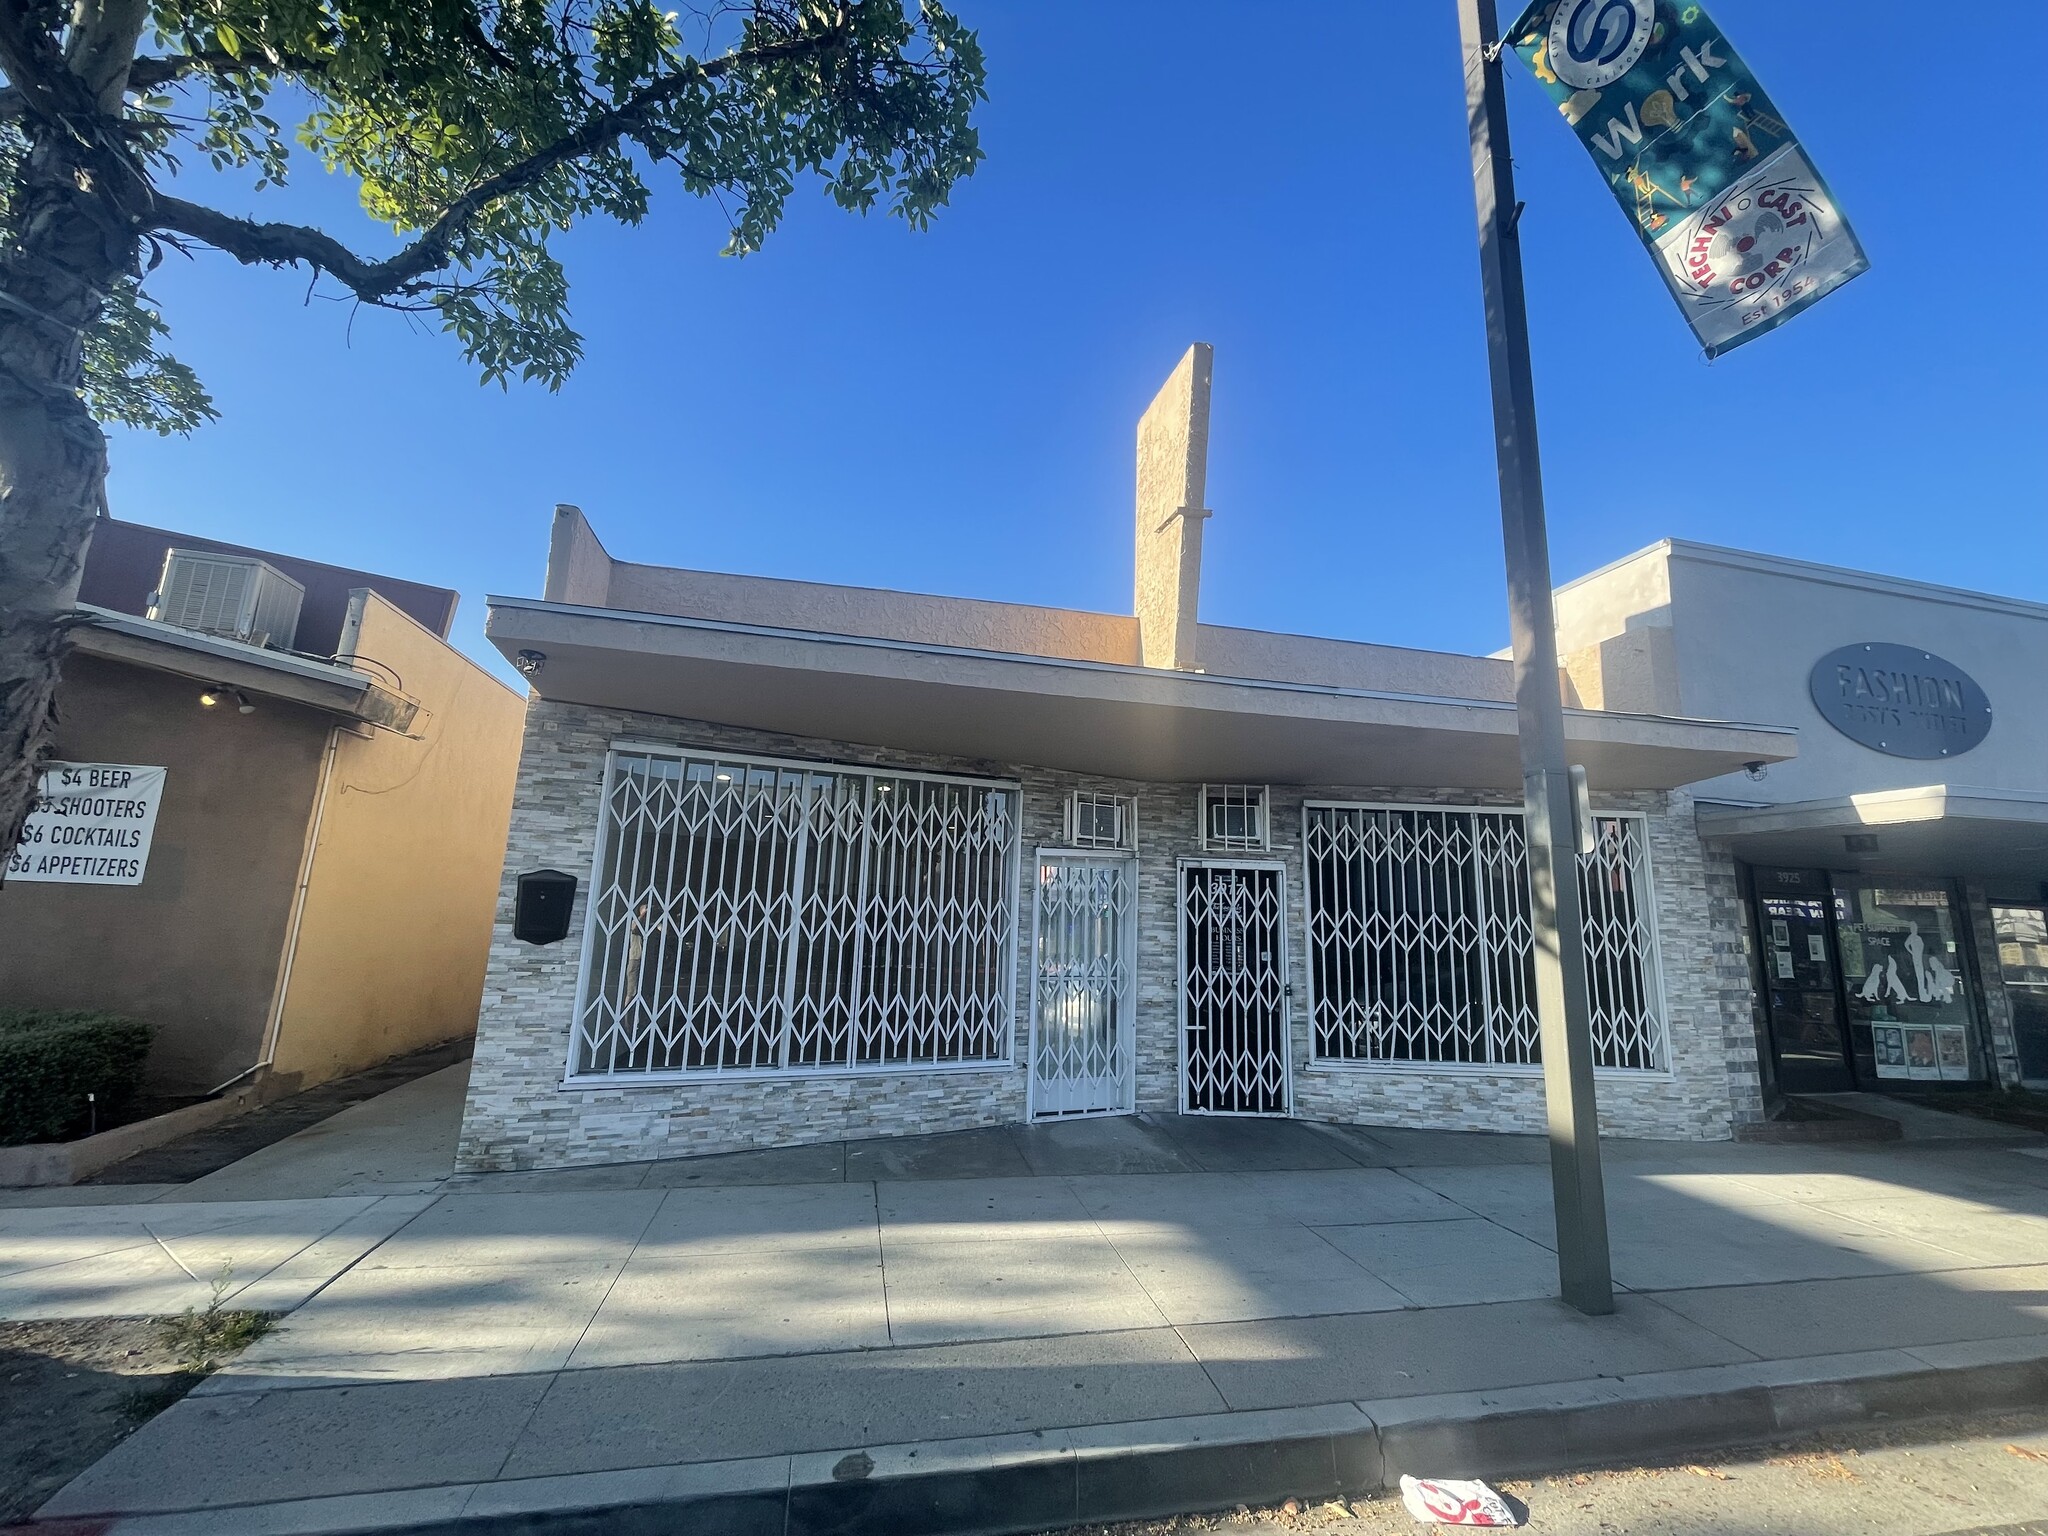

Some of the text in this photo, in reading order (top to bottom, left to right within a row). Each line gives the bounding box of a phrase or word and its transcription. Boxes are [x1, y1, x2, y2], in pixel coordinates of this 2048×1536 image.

[1587, 16, 1650, 84] CALIFORNIA
[1689, 189, 1807, 289] TECHNI CAST
[1730, 245, 1801, 294] CORP.
[1741, 276, 1815, 325] Est 1954
[1837, 664, 1965, 711] FASHION
[61, 768, 131, 788] $4 BEER
[60, 796, 147, 818] SHOOTERS
[23, 824, 141, 848] $6 COCKTAILS
[9, 854, 139, 877] $6 APPETIZERS
[1777, 872, 1800, 883] 3925
[1867, 937, 1891, 946] SPACE
